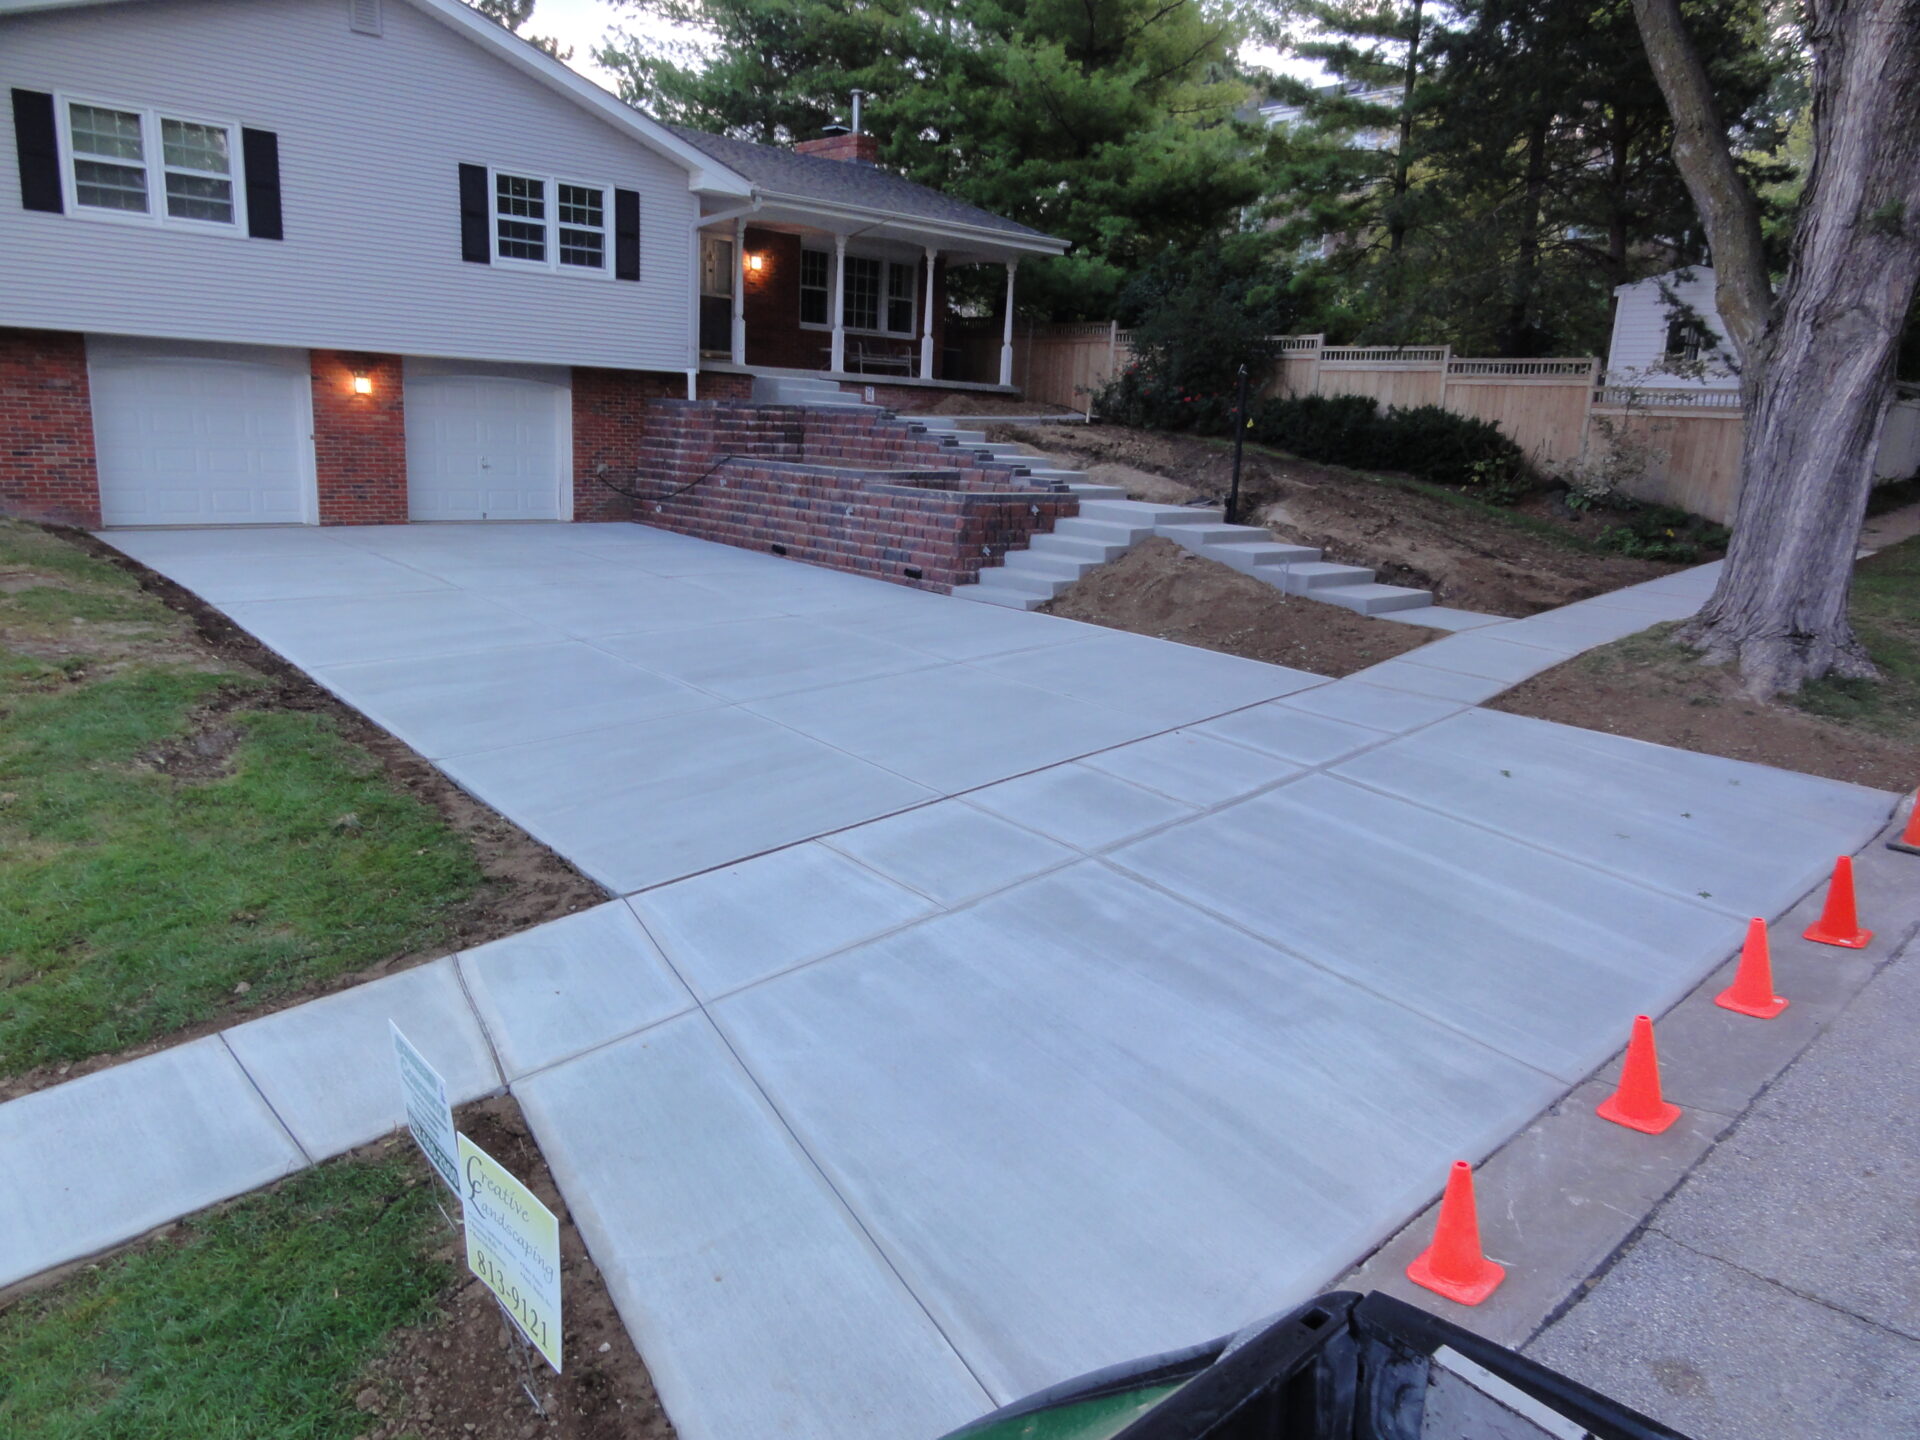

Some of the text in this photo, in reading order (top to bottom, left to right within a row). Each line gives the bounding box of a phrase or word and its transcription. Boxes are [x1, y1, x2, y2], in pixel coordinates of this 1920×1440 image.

[467, 1155, 529, 1222] Creative
[468, 1179, 555, 1283] Landscaping
[477, 1250, 549, 1349] 813-9121
